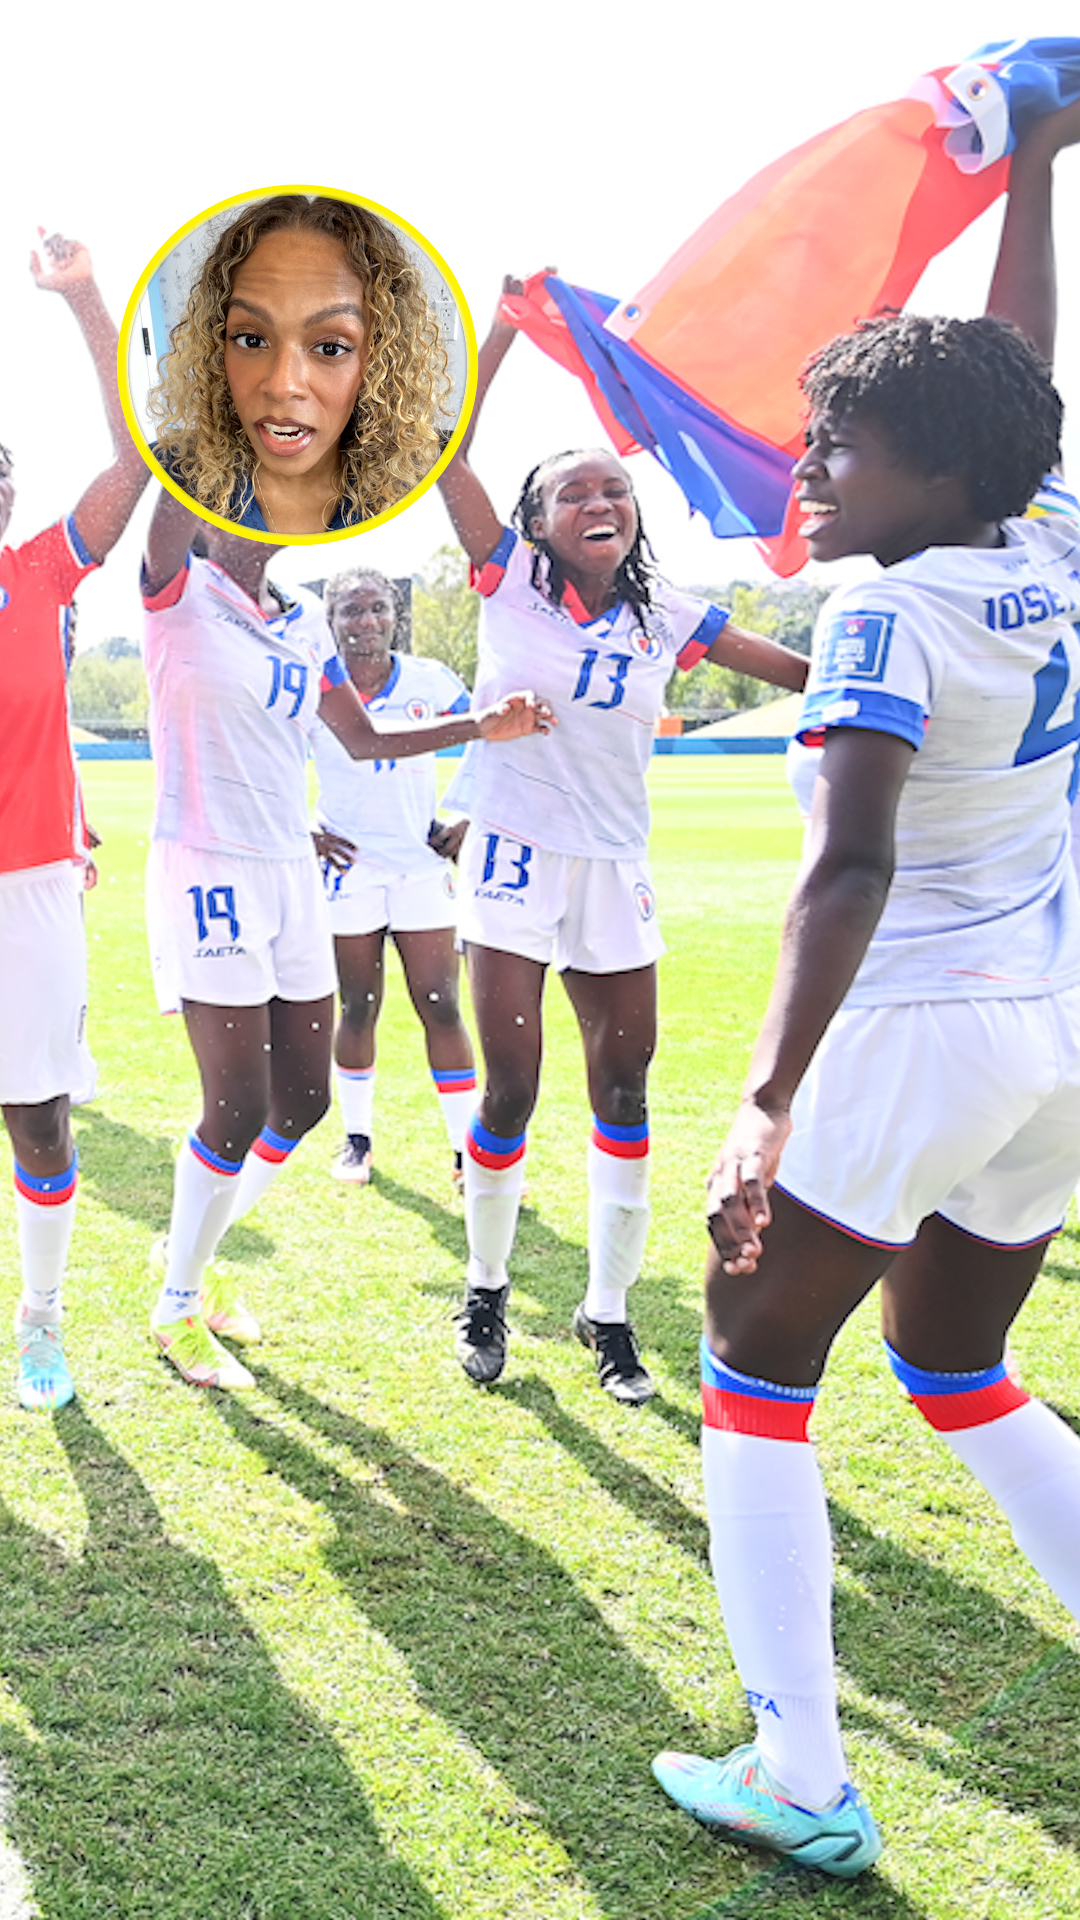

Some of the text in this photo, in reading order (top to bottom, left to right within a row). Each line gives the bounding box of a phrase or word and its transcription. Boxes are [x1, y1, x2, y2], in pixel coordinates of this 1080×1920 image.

[265, 655, 308, 719] 19
[572, 648, 633, 709] 13
[482, 833, 533, 891] 13
[186, 885, 240, 942] 19
[192, 945, 247, 958] SAETA
